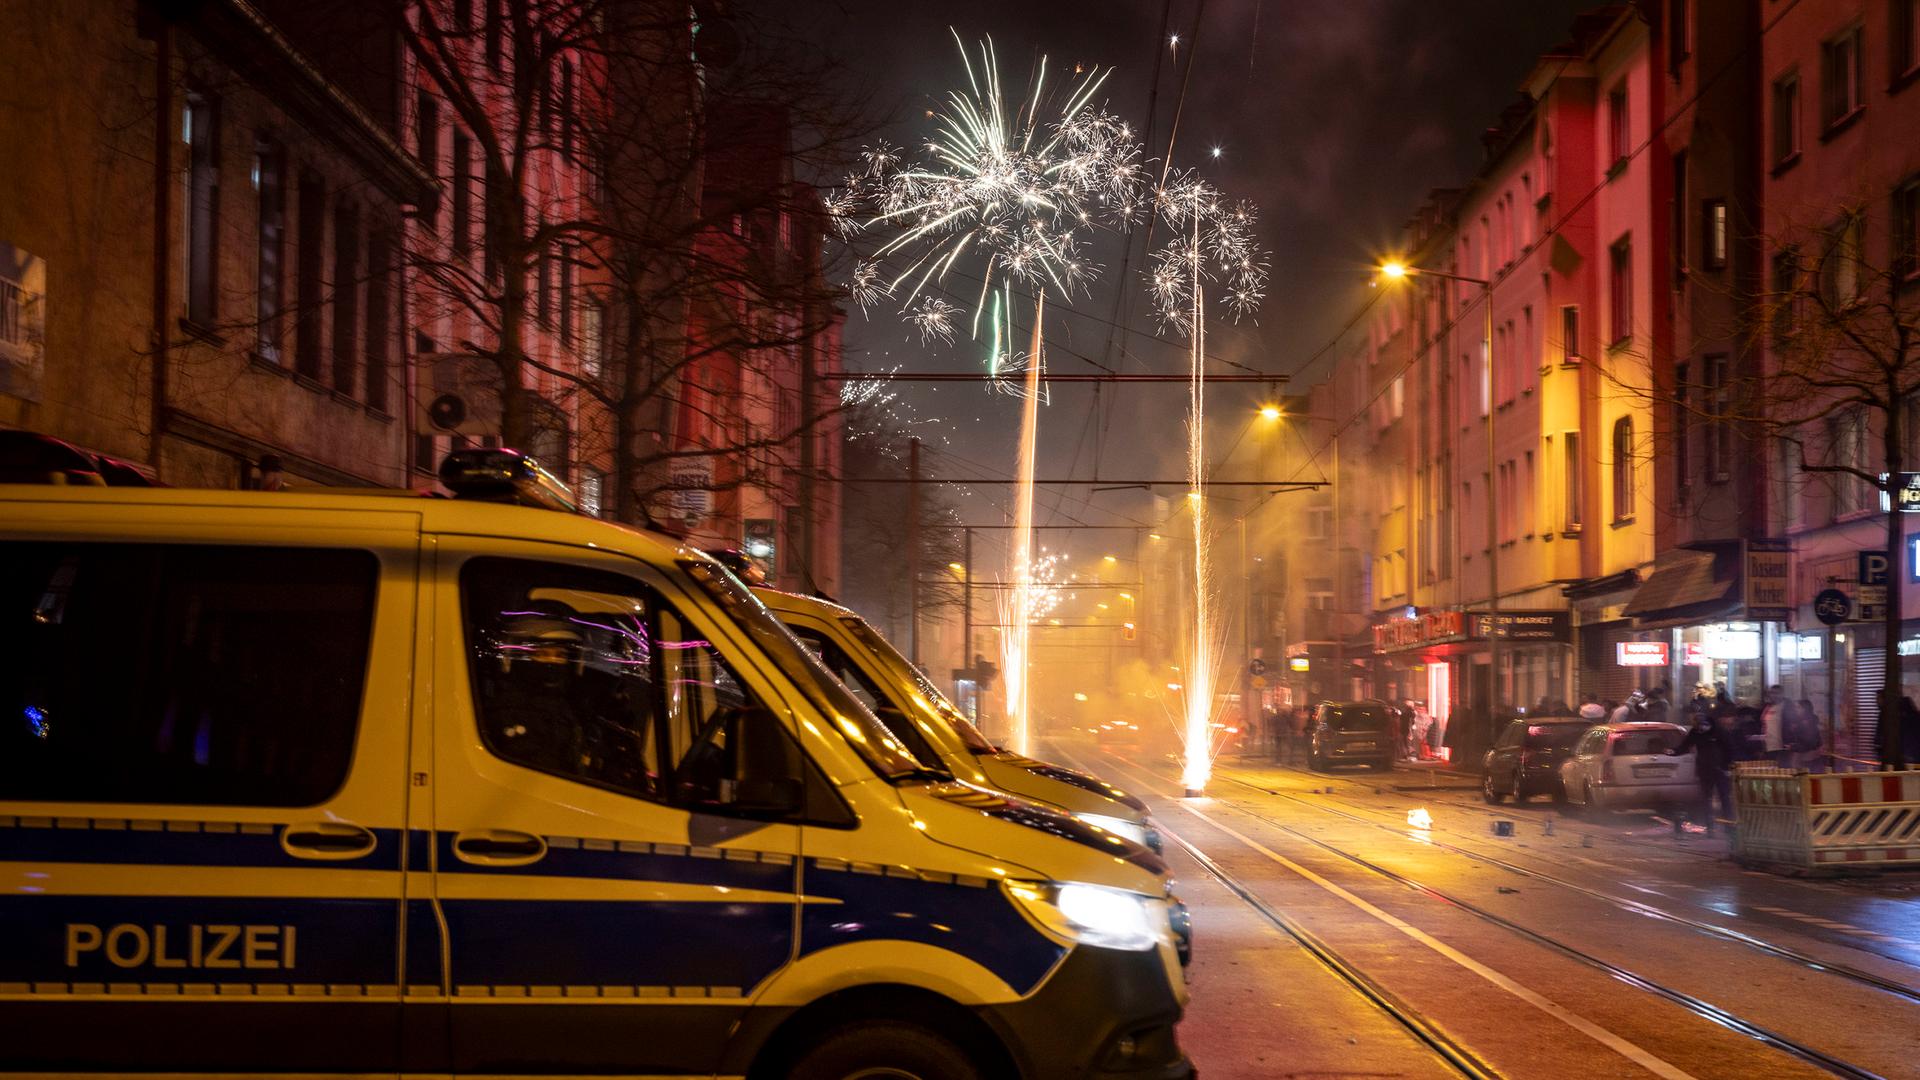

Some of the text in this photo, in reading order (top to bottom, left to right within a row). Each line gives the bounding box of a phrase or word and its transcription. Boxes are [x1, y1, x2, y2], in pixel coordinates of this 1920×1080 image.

[1867, 555, 1888, 583] P
[1516, 616, 1553, 624] MARKET
[66, 923, 297, 968] POLIZEI
